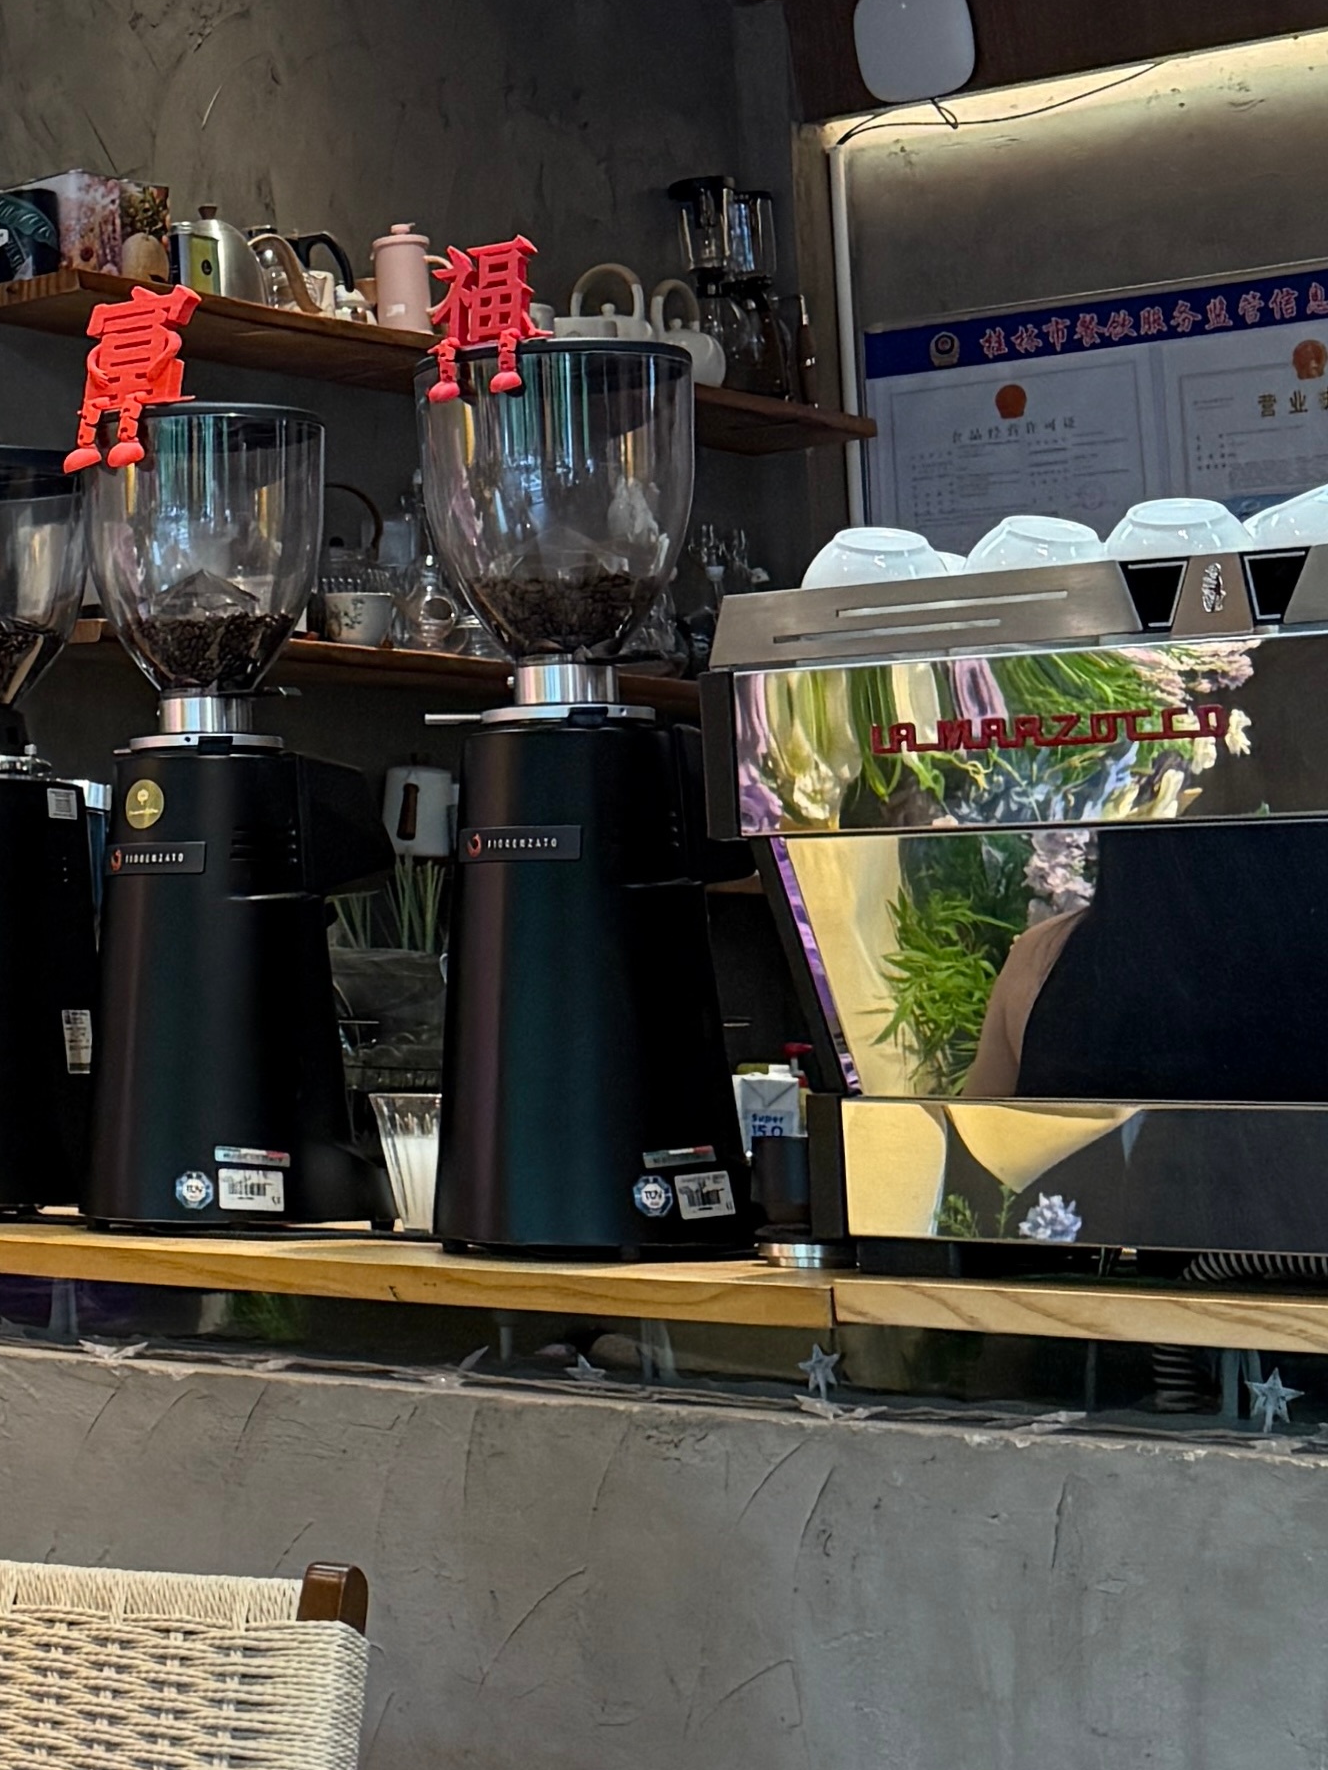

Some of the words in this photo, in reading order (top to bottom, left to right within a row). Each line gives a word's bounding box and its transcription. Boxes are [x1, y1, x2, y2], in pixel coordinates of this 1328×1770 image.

[432, 235, 554, 346] 福
[86, 284, 202, 412] 富
[871, 721, 917, 754] LA
[937, 704, 1230, 751] MARZOCCO
